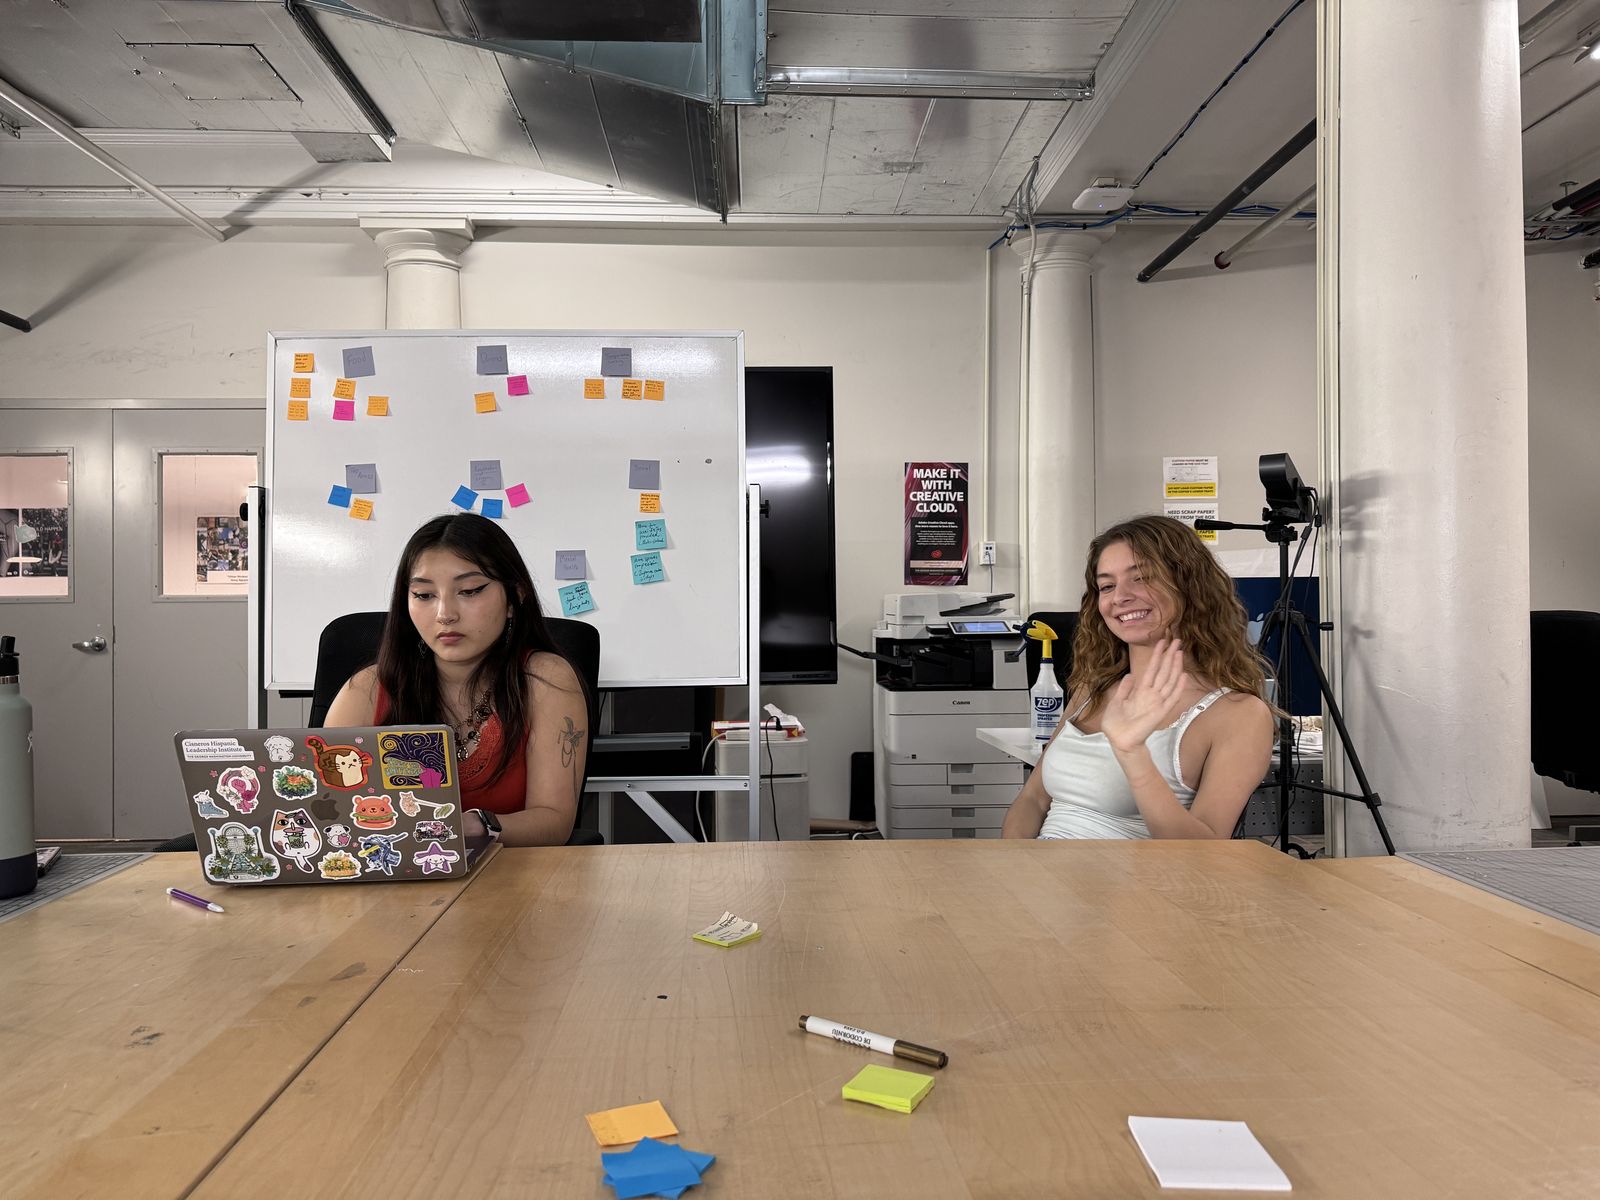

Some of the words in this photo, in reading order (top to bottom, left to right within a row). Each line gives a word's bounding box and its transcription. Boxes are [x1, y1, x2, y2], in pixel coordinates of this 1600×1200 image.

[913, 468, 948, 479] MAKE
[950, 468, 961, 479] IT
[921, 480, 952, 490] WITH
[909, 491, 964, 502] CREATIVE
[916, 502, 958, 513] CLOUD.
